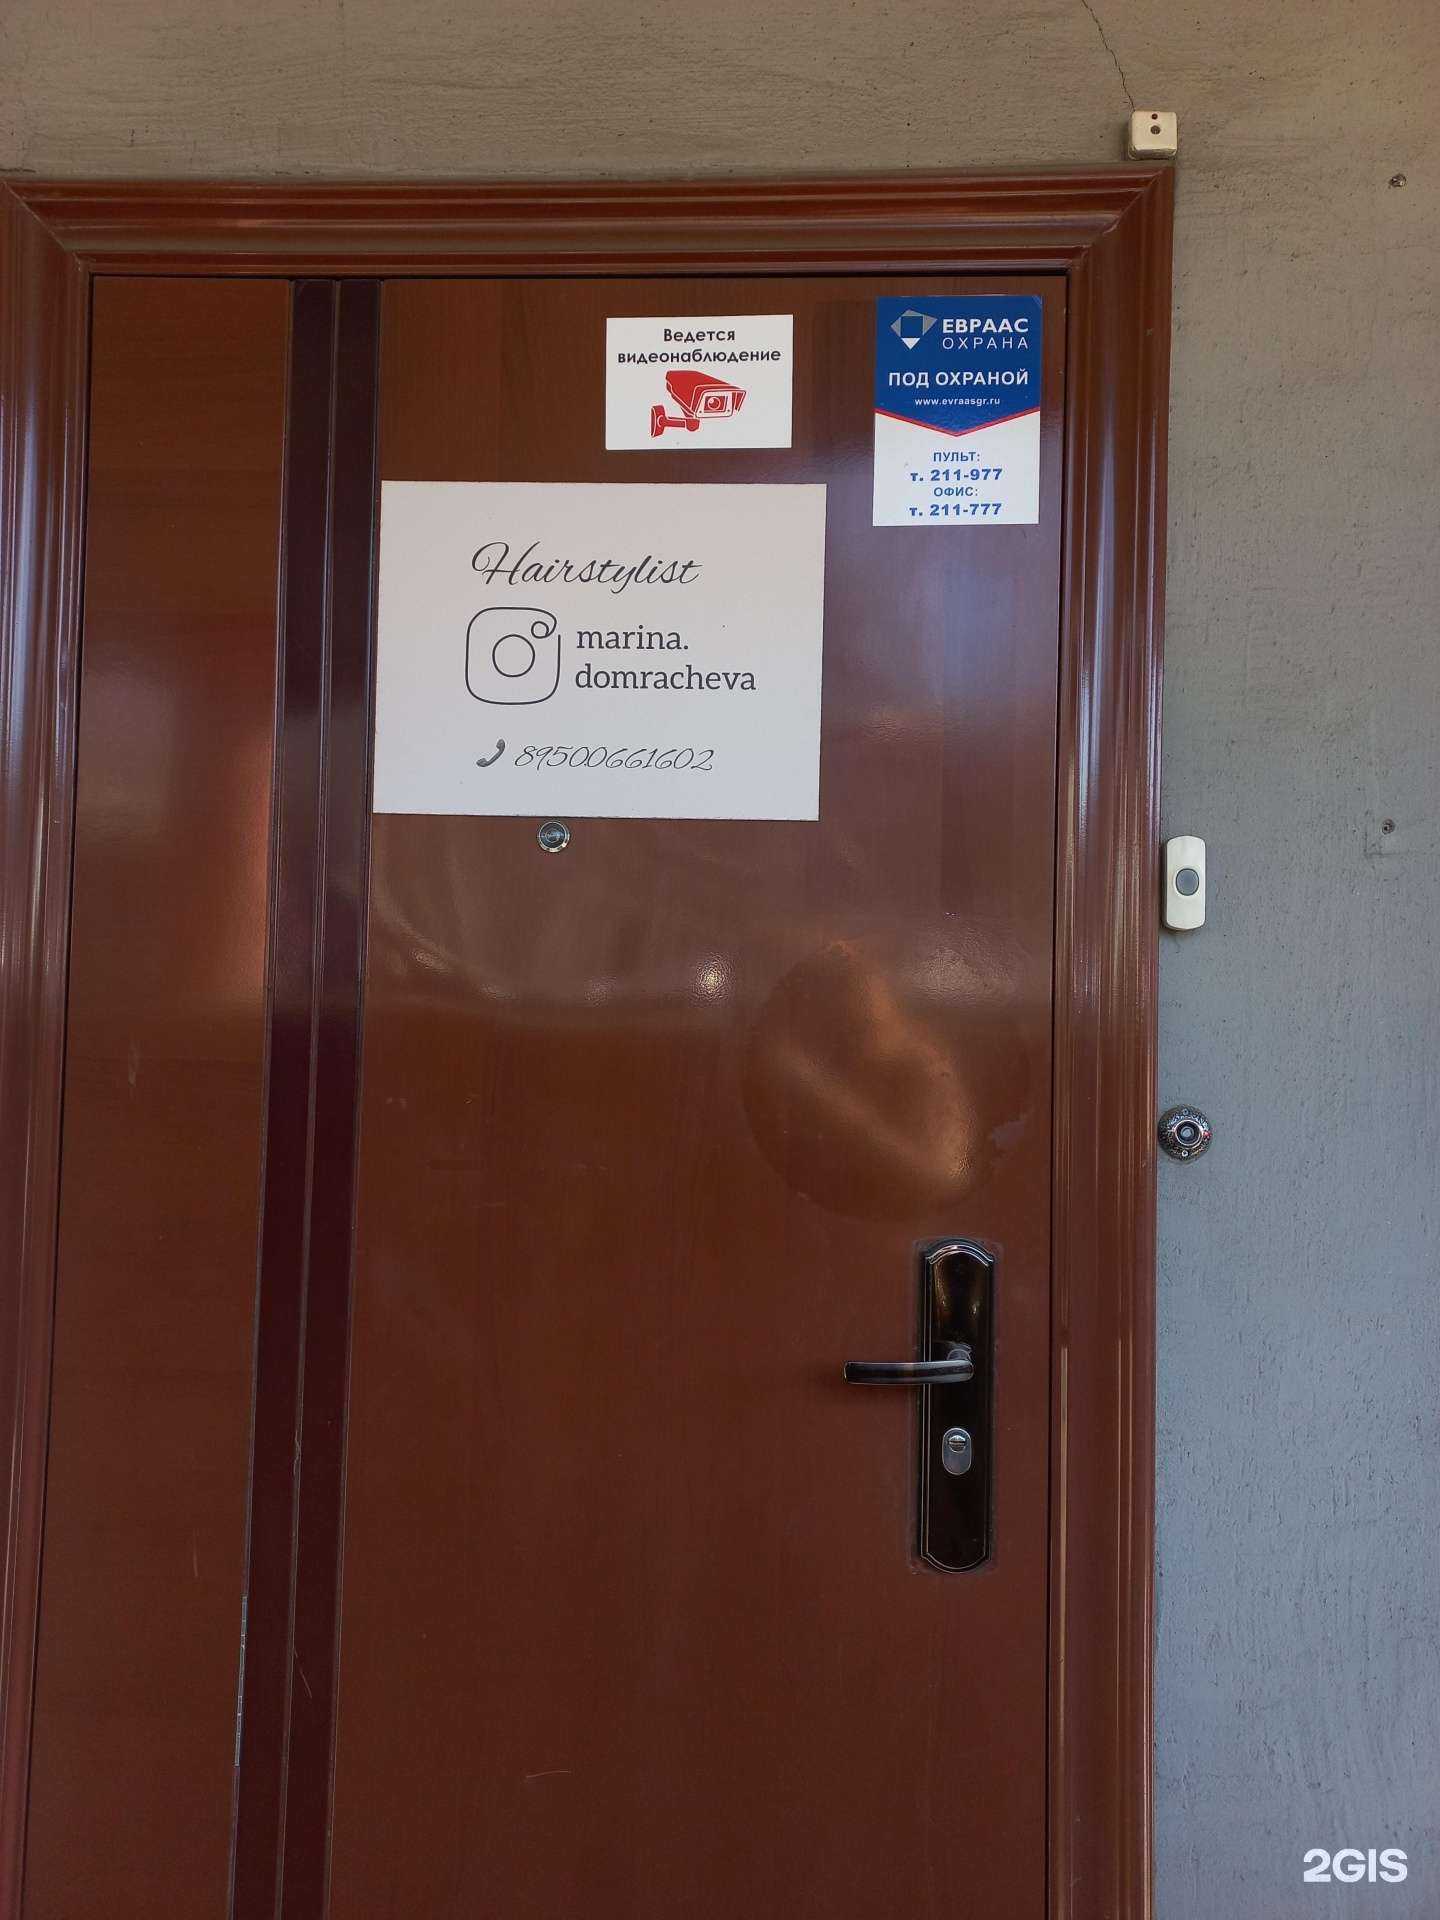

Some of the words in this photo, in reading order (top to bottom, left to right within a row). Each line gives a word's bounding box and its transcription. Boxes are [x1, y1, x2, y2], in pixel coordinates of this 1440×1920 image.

[942, 318, 1029, 334] ЕВРААС
[663, 328, 735, 343] Ведется
[942, 337, 1029, 350] ОХРАНА
[617, 349, 782, 364] видеонаблюдение
[888, 372, 930, 388] ПОД
[935, 368, 1029, 386] ОХРАНОЙ
[914, 397, 1001, 407] www.evraasgr.ru
[933, 451, 981, 462] ПУЛЬТ:
[910, 472, 924, 482] т.
[930, 468, 1003, 482] 211-977
[933, 486, 979, 497] ОФИС:
[909, 506, 923, 517] т.
[929, 503, 1002, 517] 211-777
[471, 541, 703, 594] Hairstylist
[575, 624, 690, 651] marina.
[574, 662, 757, 691] domracheva
[513, 744, 715, 771] 89500661602
